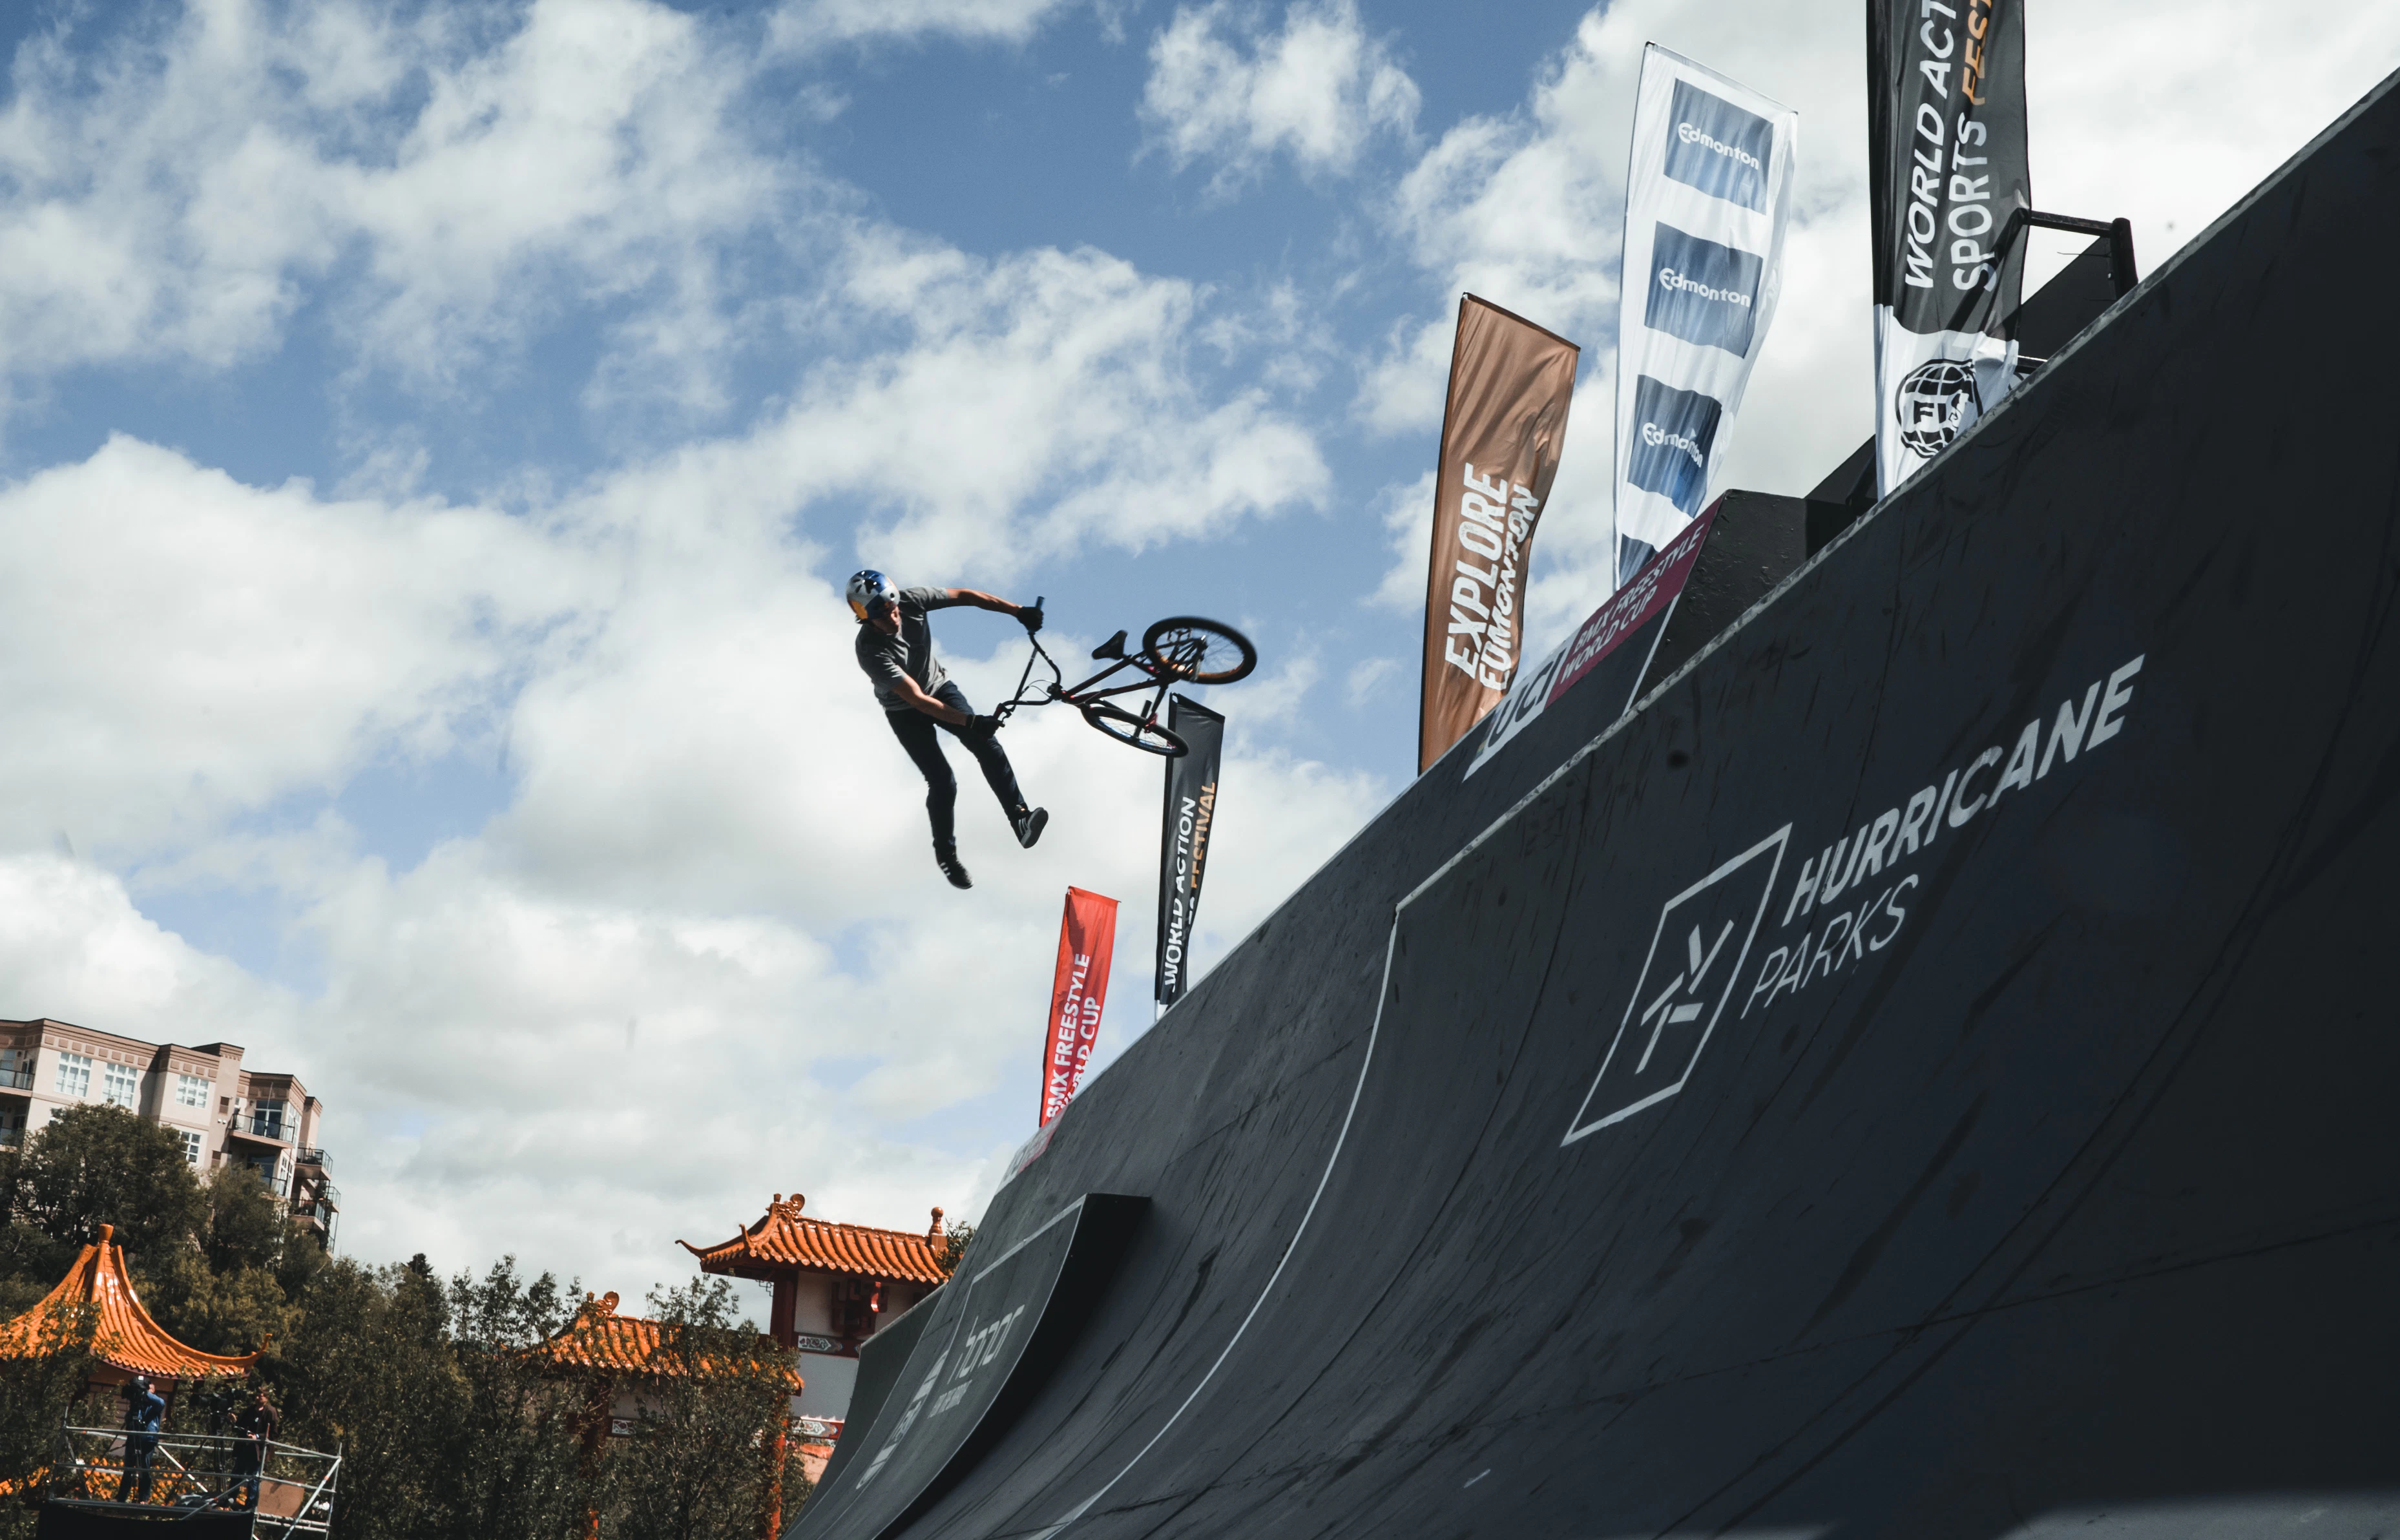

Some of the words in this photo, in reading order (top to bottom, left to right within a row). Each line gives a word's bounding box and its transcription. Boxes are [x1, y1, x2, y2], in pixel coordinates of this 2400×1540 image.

[1678, 122, 1759, 171] Edmonton
[1904, 102, 1945, 289] WORLD
[1948, 112, 1998, 293] SPORTS
[1659, 267, 1751, 307] Edmonton
[1445, 462, 1508, 679] EXPLORE
[1479, 483, 1539, 691] EDMONTON
[1560, 619, 1620, 685] WORLD
[1620, 585, 1658, 631] CUP
[1572, 603, 1615, 656] BMX
[1610, 523, 1705, 621] FREESTYLE
[1488, 647, 1568, 748] UCI
[1782, 653, 2145, 927] HURRICANE
[1164, 898, 1183, 993] WORLD
[1176, 796, 1196, 893] ACTION
[1740, 874, 1919, 1020] PARKS
[1054, 953, 1090, 1067] FREESTYLE
[1080, 997, 1101, 1040] CUP
[1046, 1068, 1070, 1118] BMX
